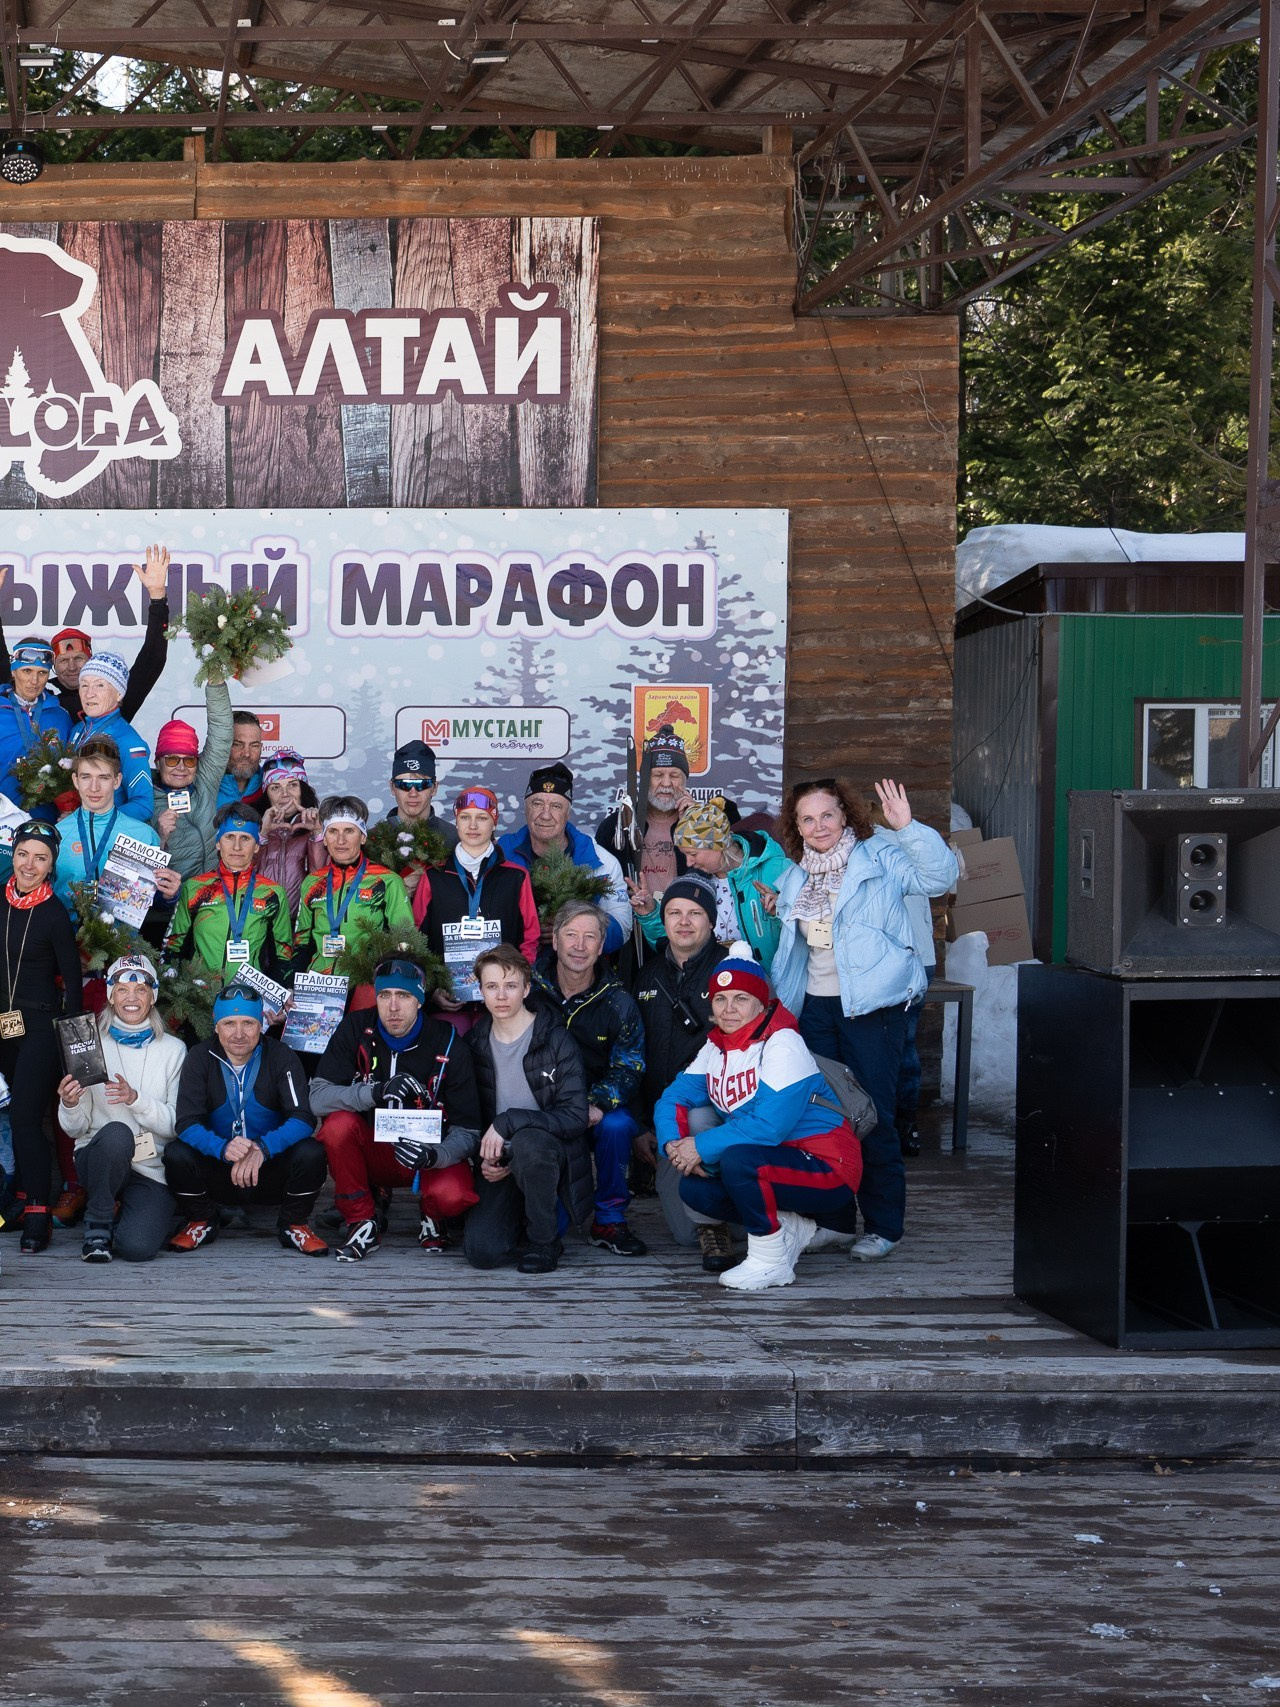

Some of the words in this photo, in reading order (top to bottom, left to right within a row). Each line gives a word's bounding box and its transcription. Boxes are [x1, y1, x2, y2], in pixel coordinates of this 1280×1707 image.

[220, 286, 561, 396] АЛТАЙ
[339, 562, 704, 627] МАРАФОН
[452, 719, 543, 738] МУСТАНГ
[116, 835, 168, 864] ГРАМОТА
[123, 848, 145, 862] ПЕРВОЕ
[240, 963, 287, 1000] ГРАМОТА
[243, 977, 265, 995] ПЕРВОЕ
[265, 991, 283, 1007] МЕСТО
[295, 974, 348, 986] ГРАМОТА
[303, 985, 325, 993] ВТОРОЕ
[706, 1066, 757, 1108] USSIA
